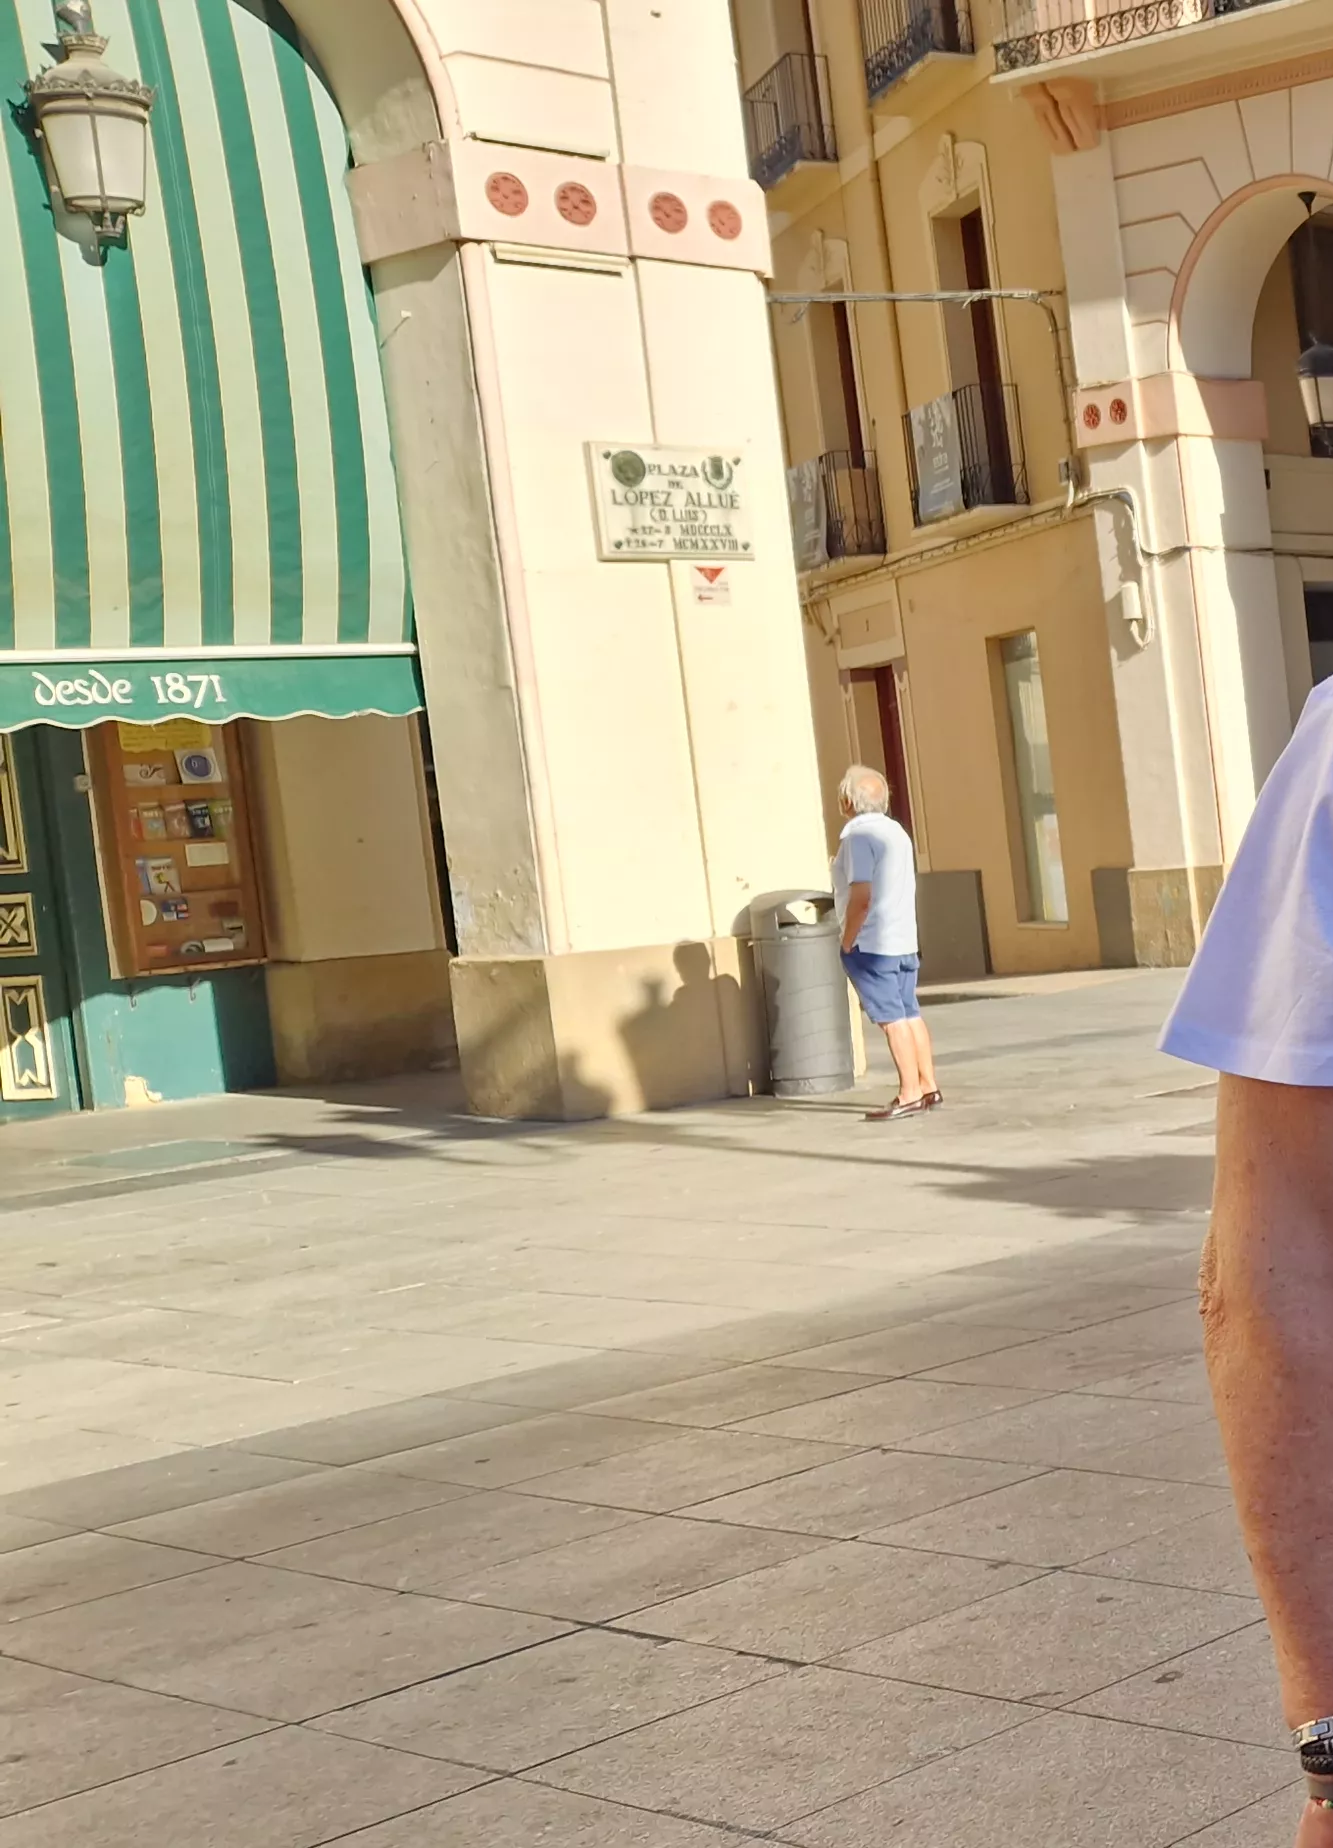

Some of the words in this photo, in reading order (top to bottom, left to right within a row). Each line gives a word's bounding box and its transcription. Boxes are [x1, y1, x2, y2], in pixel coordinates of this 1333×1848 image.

[648, 463, 700, 478] PLAZA
[684, 490, 740, 510] ALLUÉ
[31, 669, 134, 706] desde
[150, 672, 227, 708] 1871
